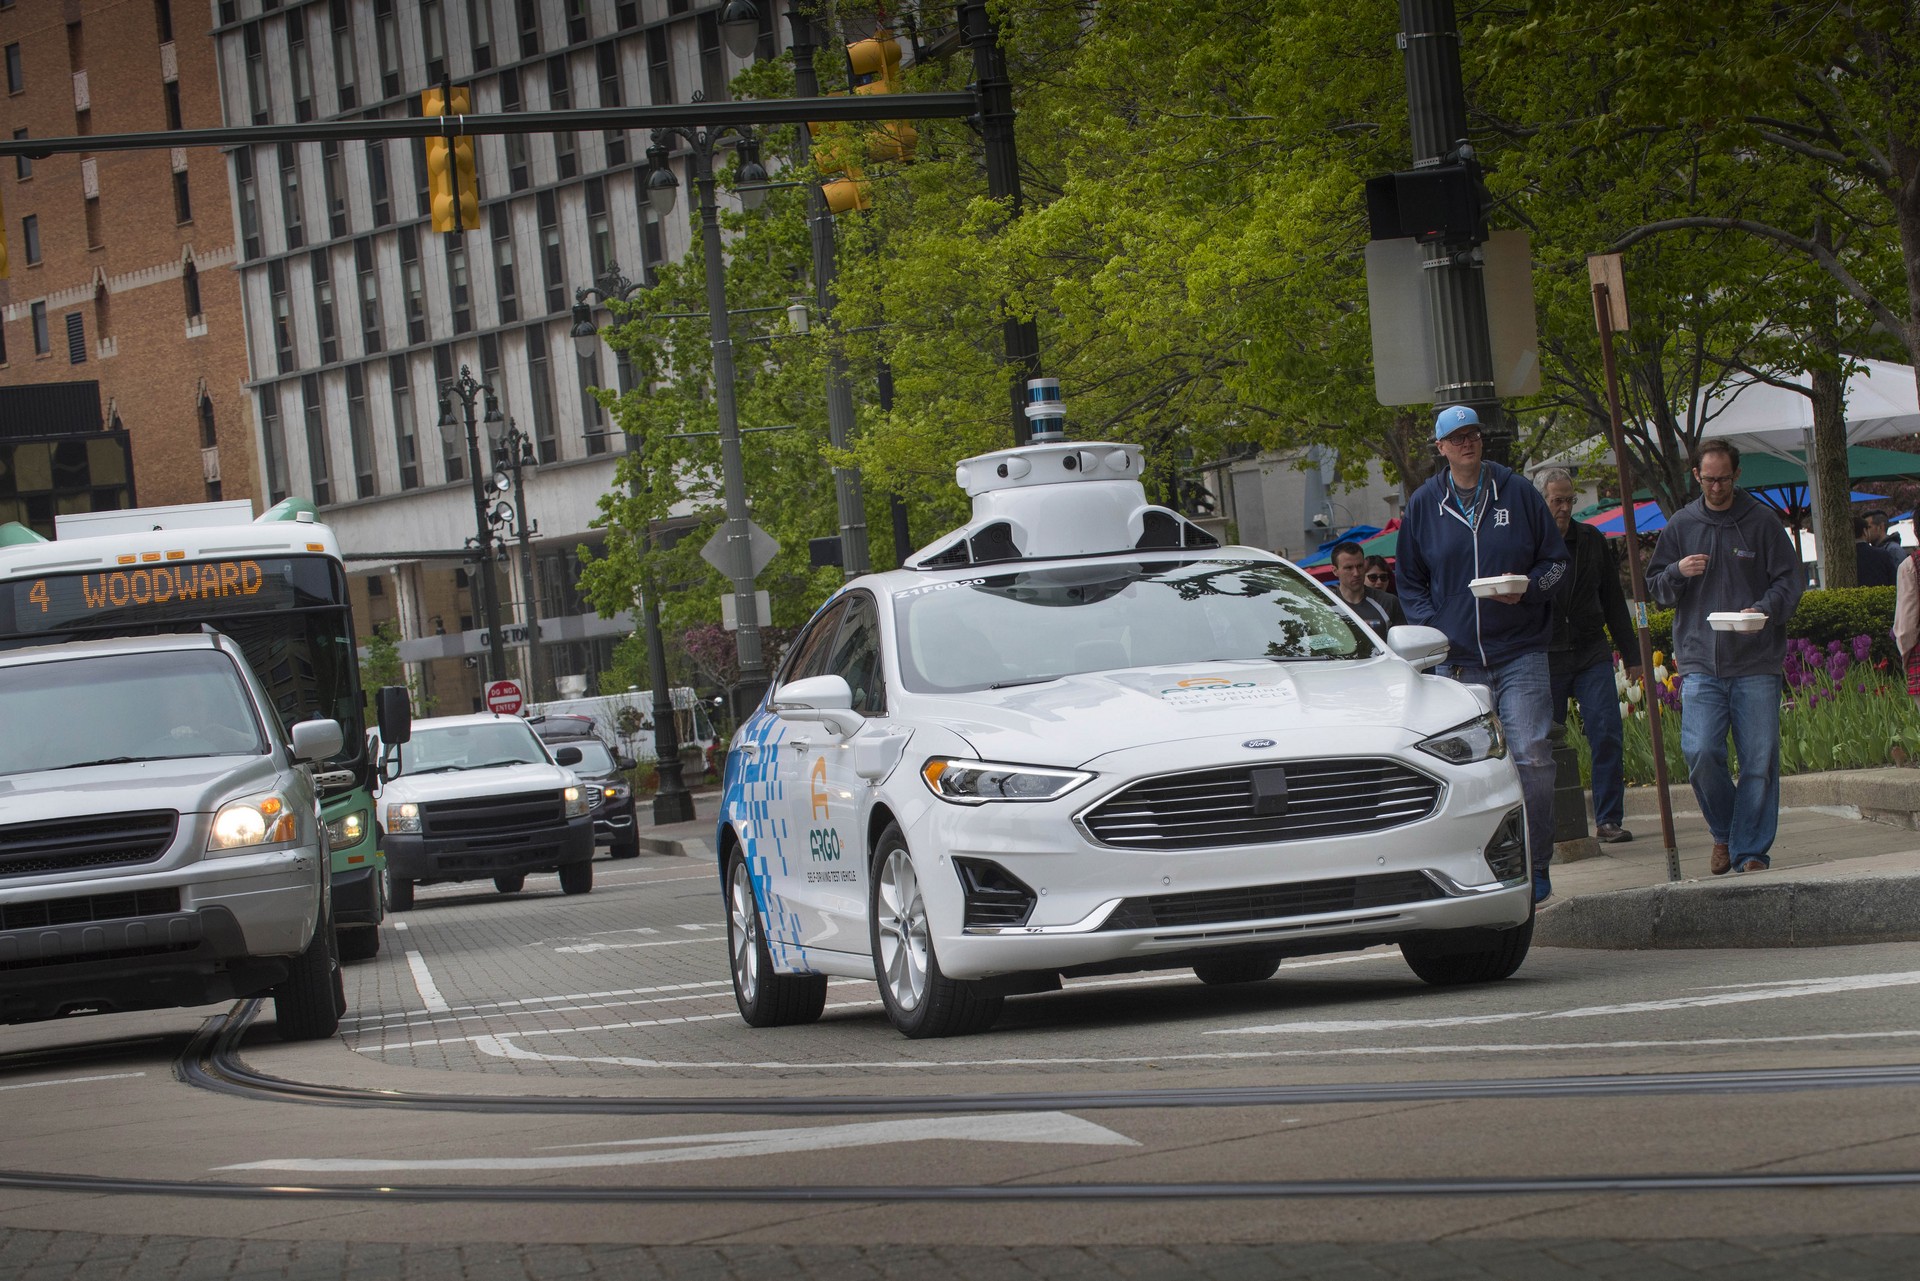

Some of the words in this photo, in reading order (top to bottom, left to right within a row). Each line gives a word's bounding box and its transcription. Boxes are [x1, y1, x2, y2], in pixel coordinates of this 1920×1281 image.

[29, 579, 50, 612] 4
[82, 560, 263, 608] WOODWARD
[895, 578, 986, 599] Z1F0020
[1217, 692, 1291, 701] VEHICLE
[495, 703, 516, 712] ENTER
[809, 827, 841, 862] ARGO
